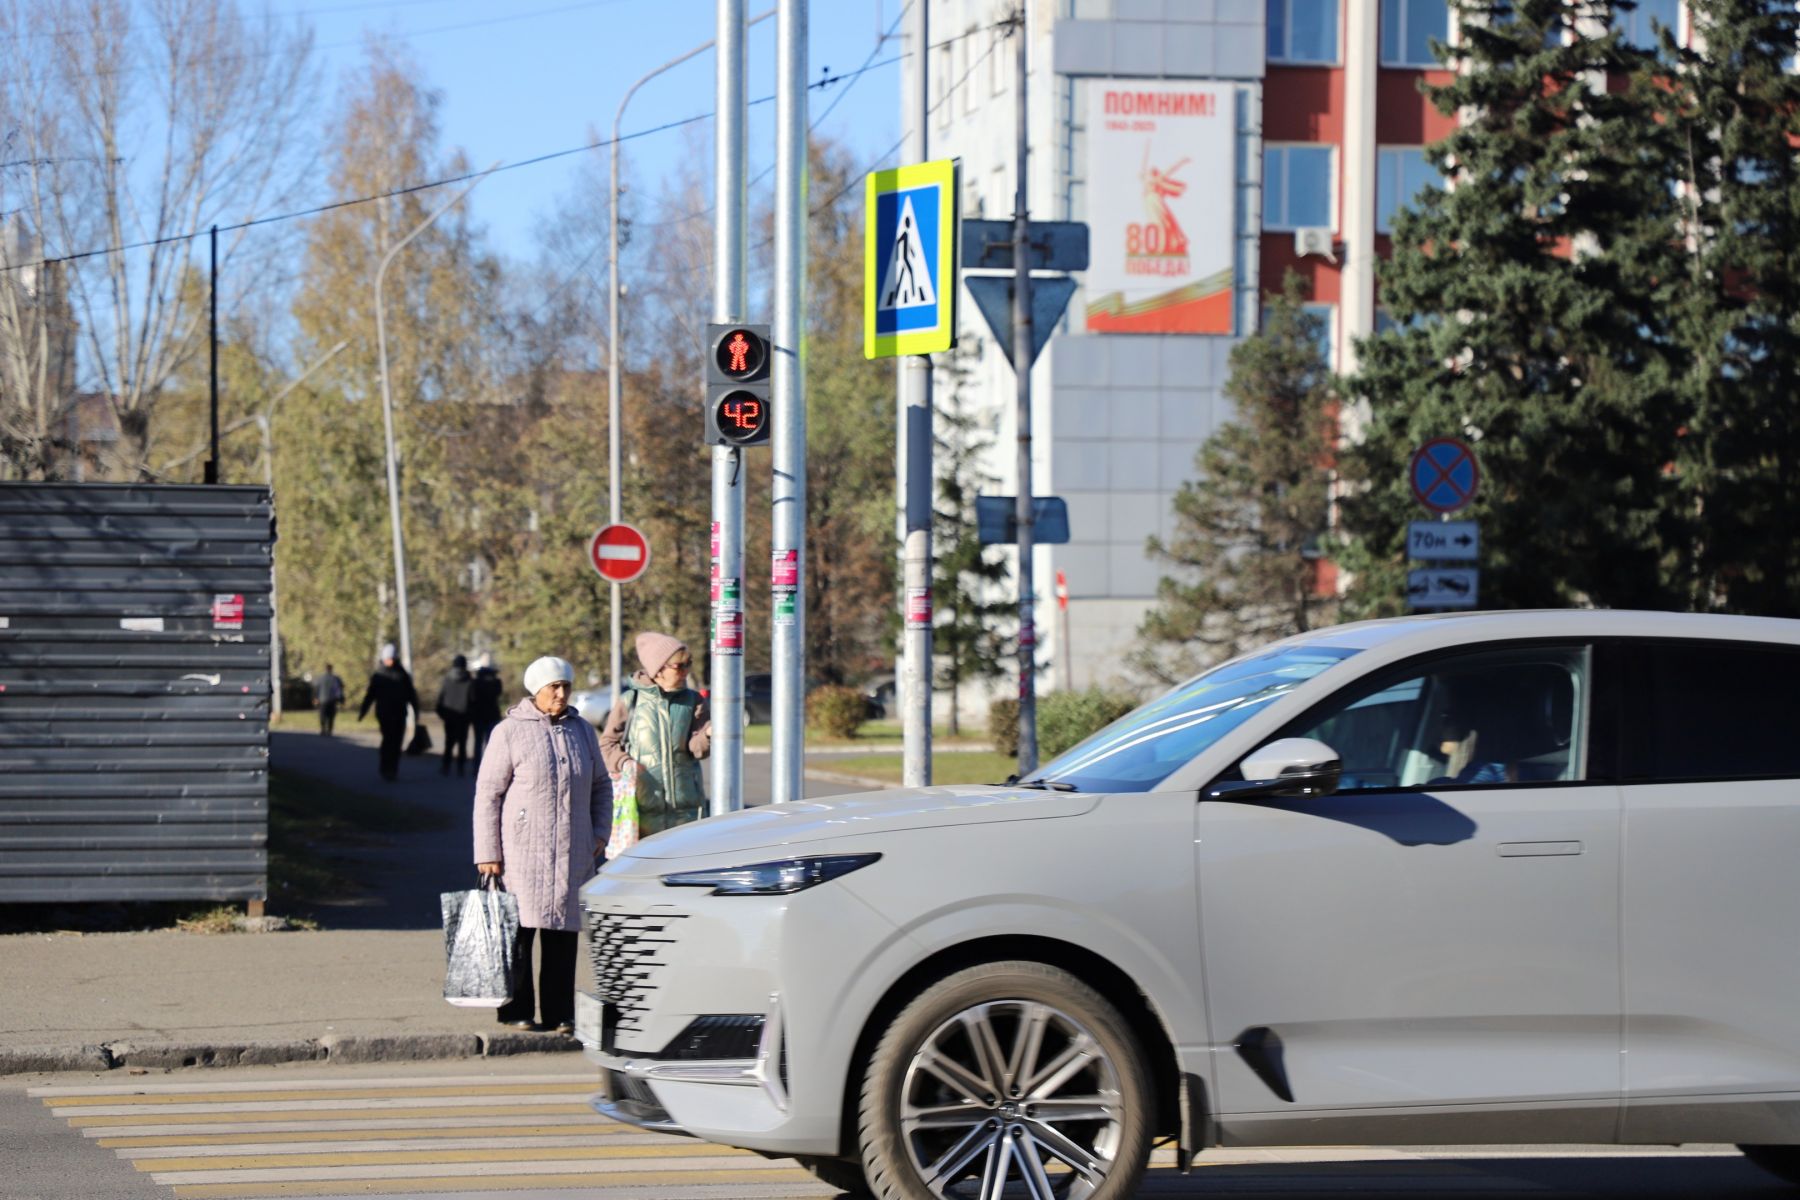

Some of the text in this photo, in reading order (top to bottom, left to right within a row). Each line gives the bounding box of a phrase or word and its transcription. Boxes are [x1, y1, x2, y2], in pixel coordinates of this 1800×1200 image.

[1104, 91, 1216, 117] ПОМНИМ!
[1126, 223, 1160, 254] 80
[1125, 257, 1190, 276] ПОБЕДА!
[724, 401, 759, 429] 42
